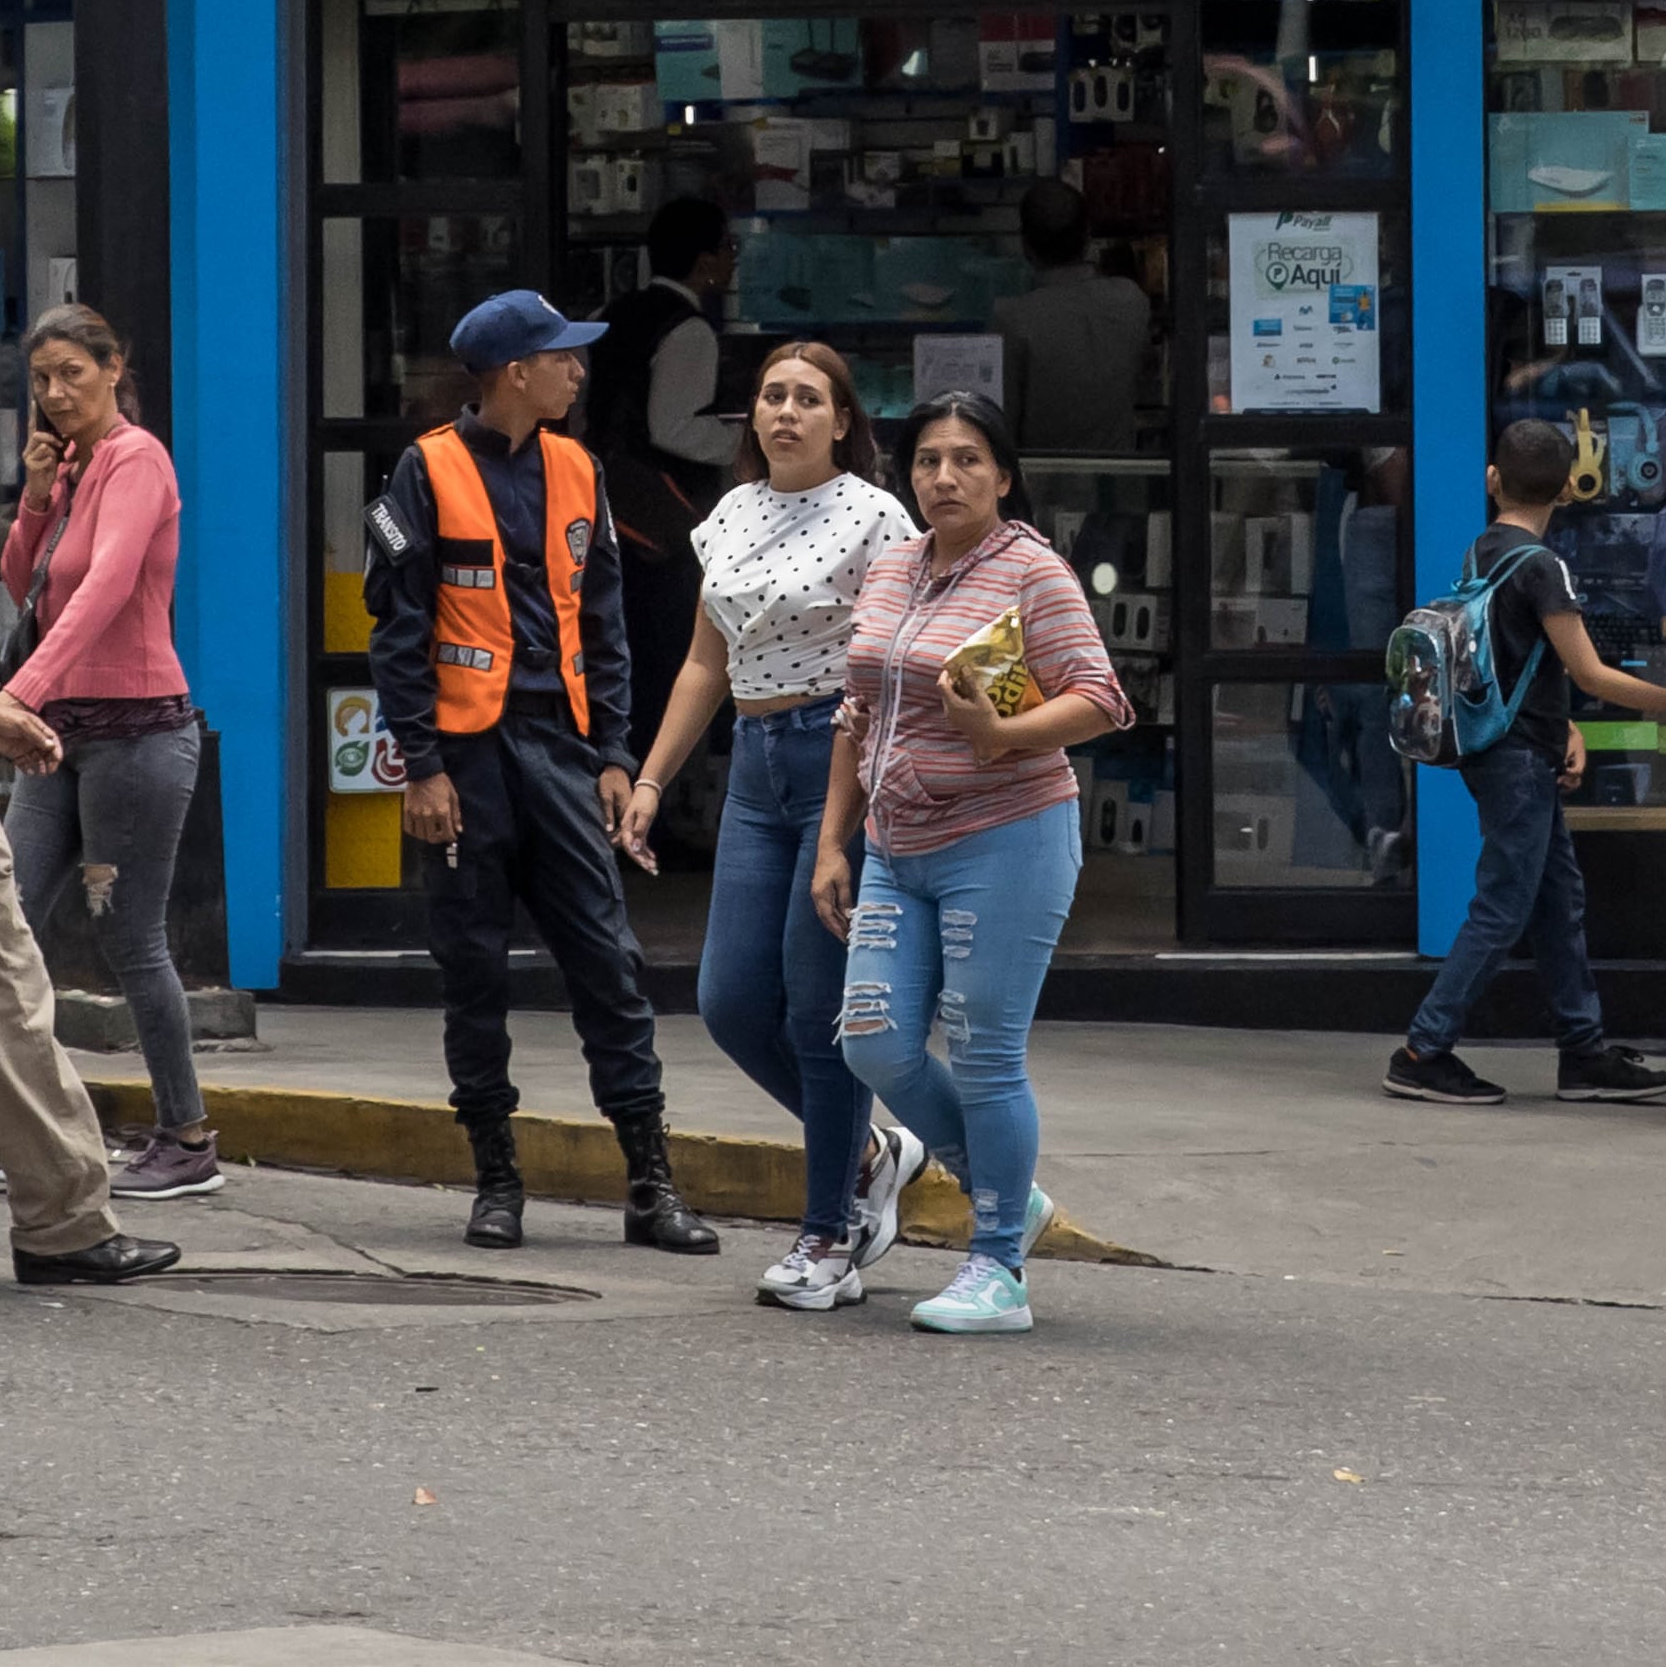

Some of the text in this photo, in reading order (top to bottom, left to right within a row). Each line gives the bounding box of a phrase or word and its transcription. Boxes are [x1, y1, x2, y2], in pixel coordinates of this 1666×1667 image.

[1267, 242, 1342, 262] Recarga
[1290, 261, 1342, 291] Aquí
[371, 503, 407, 551] TRANSITO
